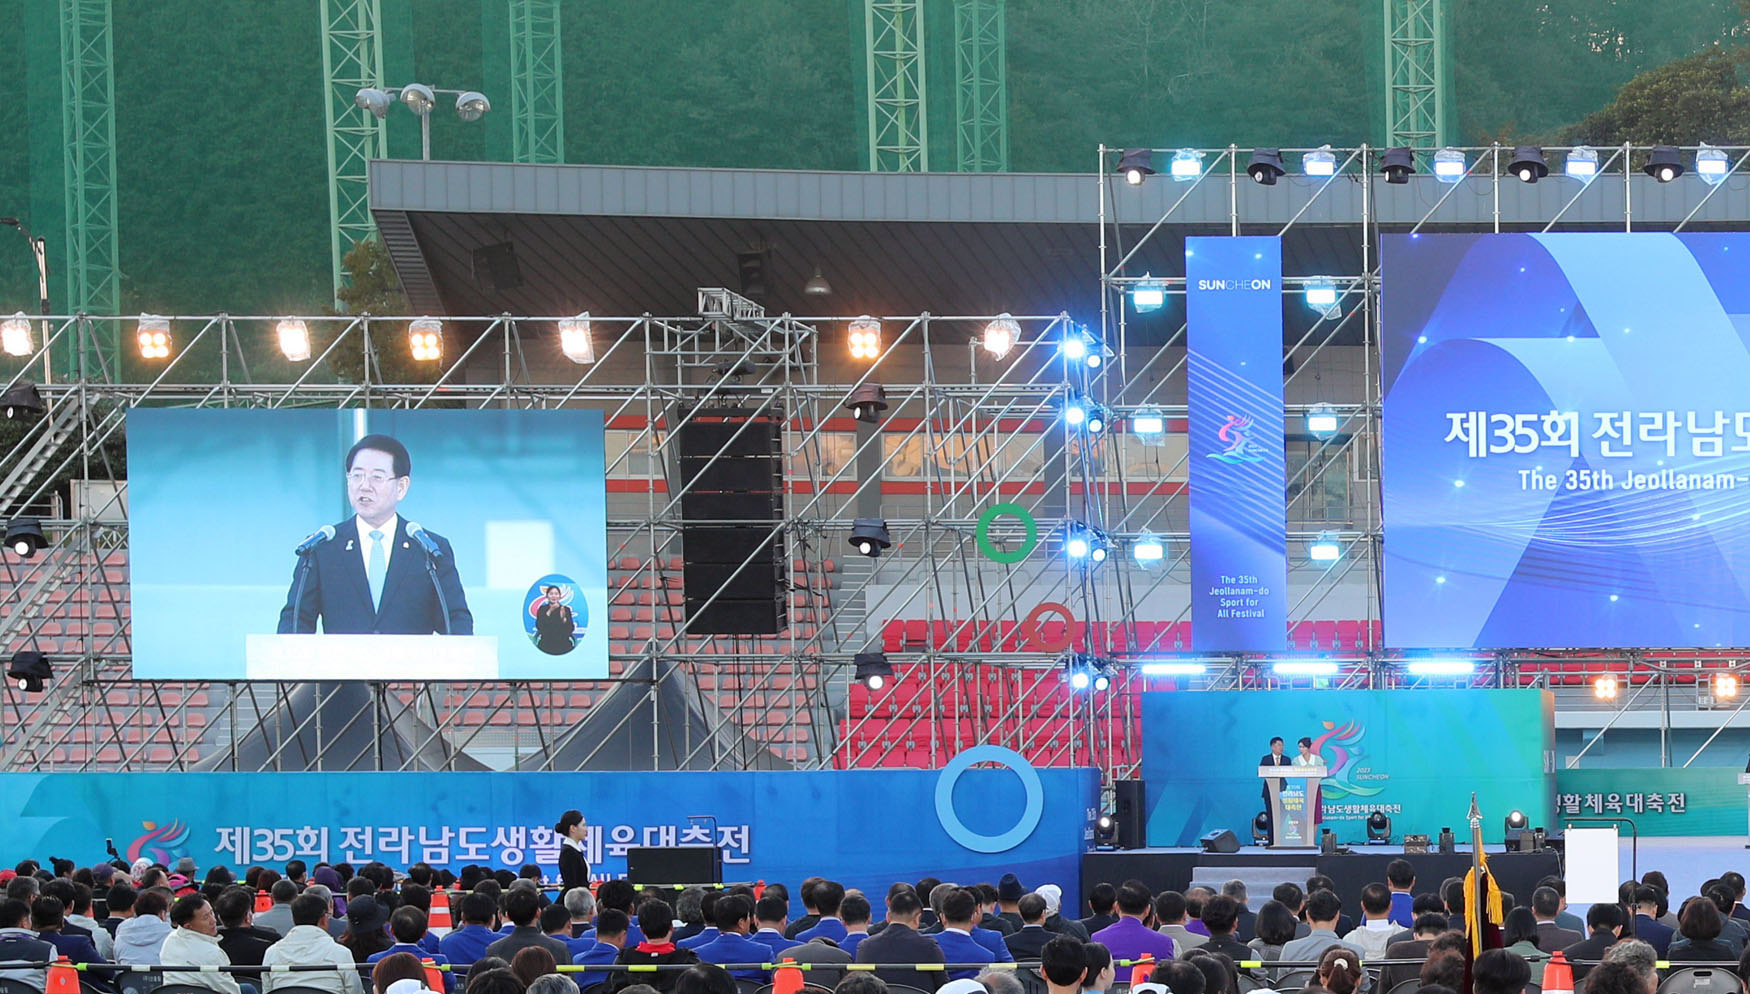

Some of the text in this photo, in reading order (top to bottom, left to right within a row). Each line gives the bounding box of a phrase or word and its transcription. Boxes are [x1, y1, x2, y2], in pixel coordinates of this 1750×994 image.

[1198, 279, 1271, 290] SUNCHEON
[1444, 410, 1580, 457] 제35회
[1518, 469, 1557, 490] The
[1565, 469, 1613, 490] 35th
[1221, 575, 1258, 584] The 35th
[1209, 586, 1270, 596] Jeollanam-do
[1220, 597, 1259, 607] Sport for
[1217, 608, 1265, 618] All Festival
[214, 825, 328, 865] 제35회
